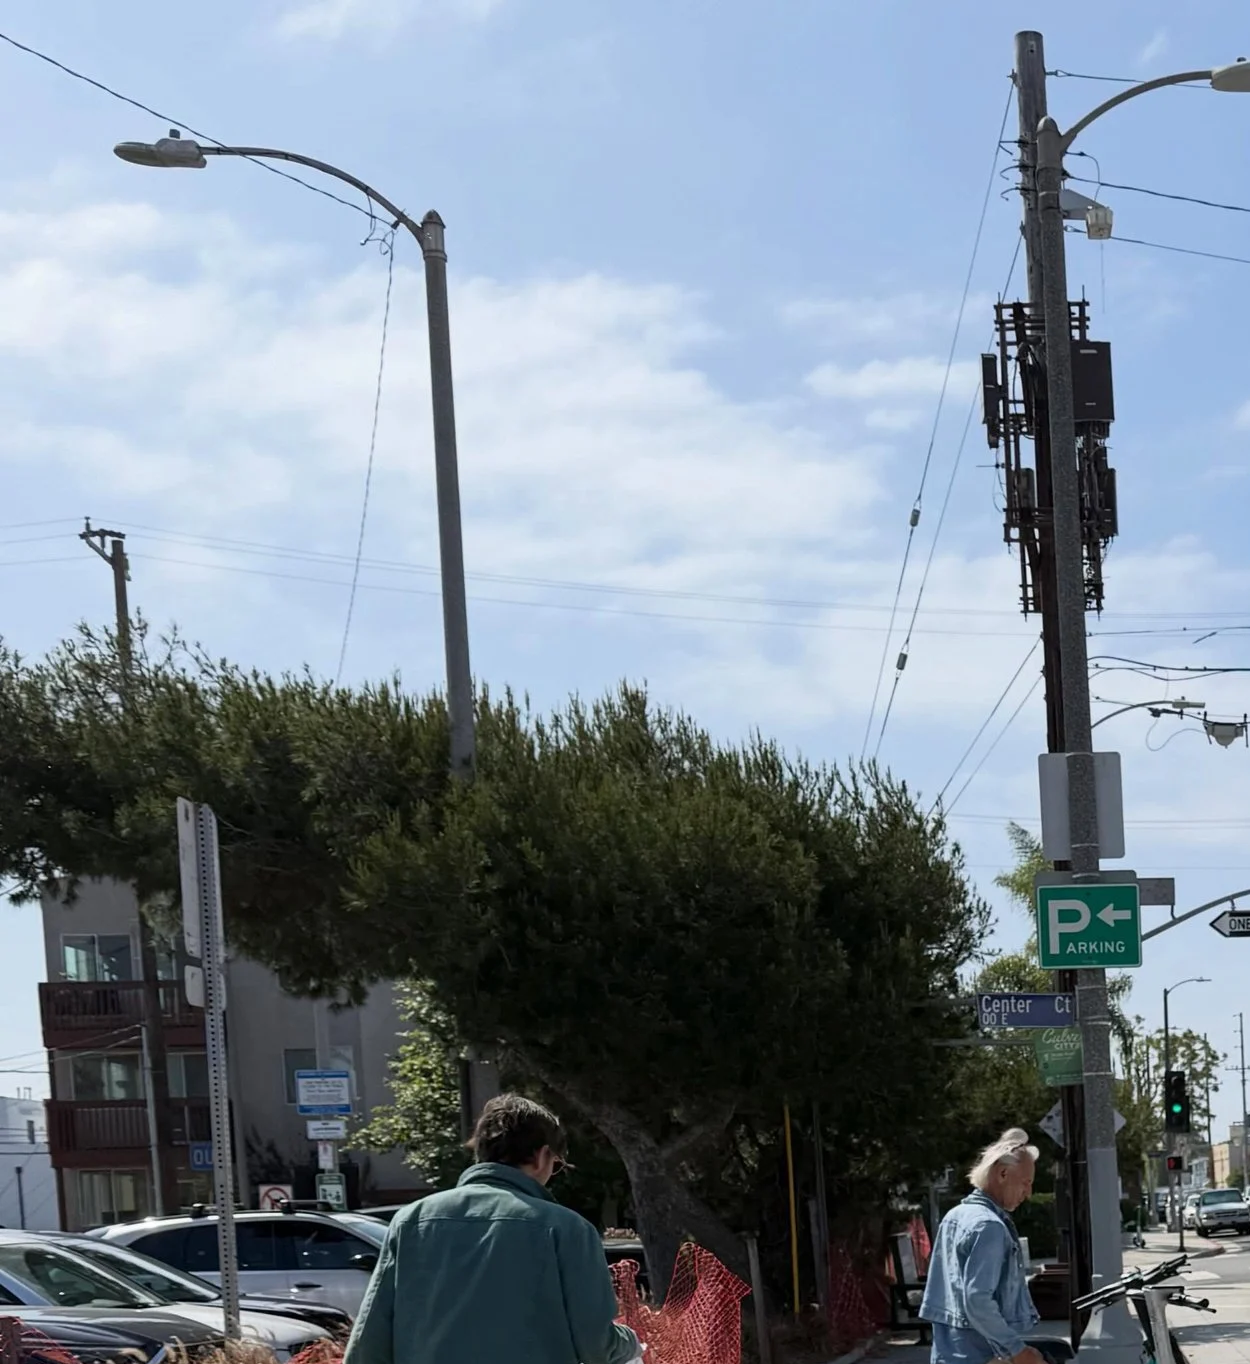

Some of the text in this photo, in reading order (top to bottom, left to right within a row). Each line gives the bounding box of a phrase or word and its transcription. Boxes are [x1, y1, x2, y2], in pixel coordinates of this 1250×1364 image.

[981, 995, 1071, 1013] Center Ct
[1001, 1013, 1008, 1025] E
